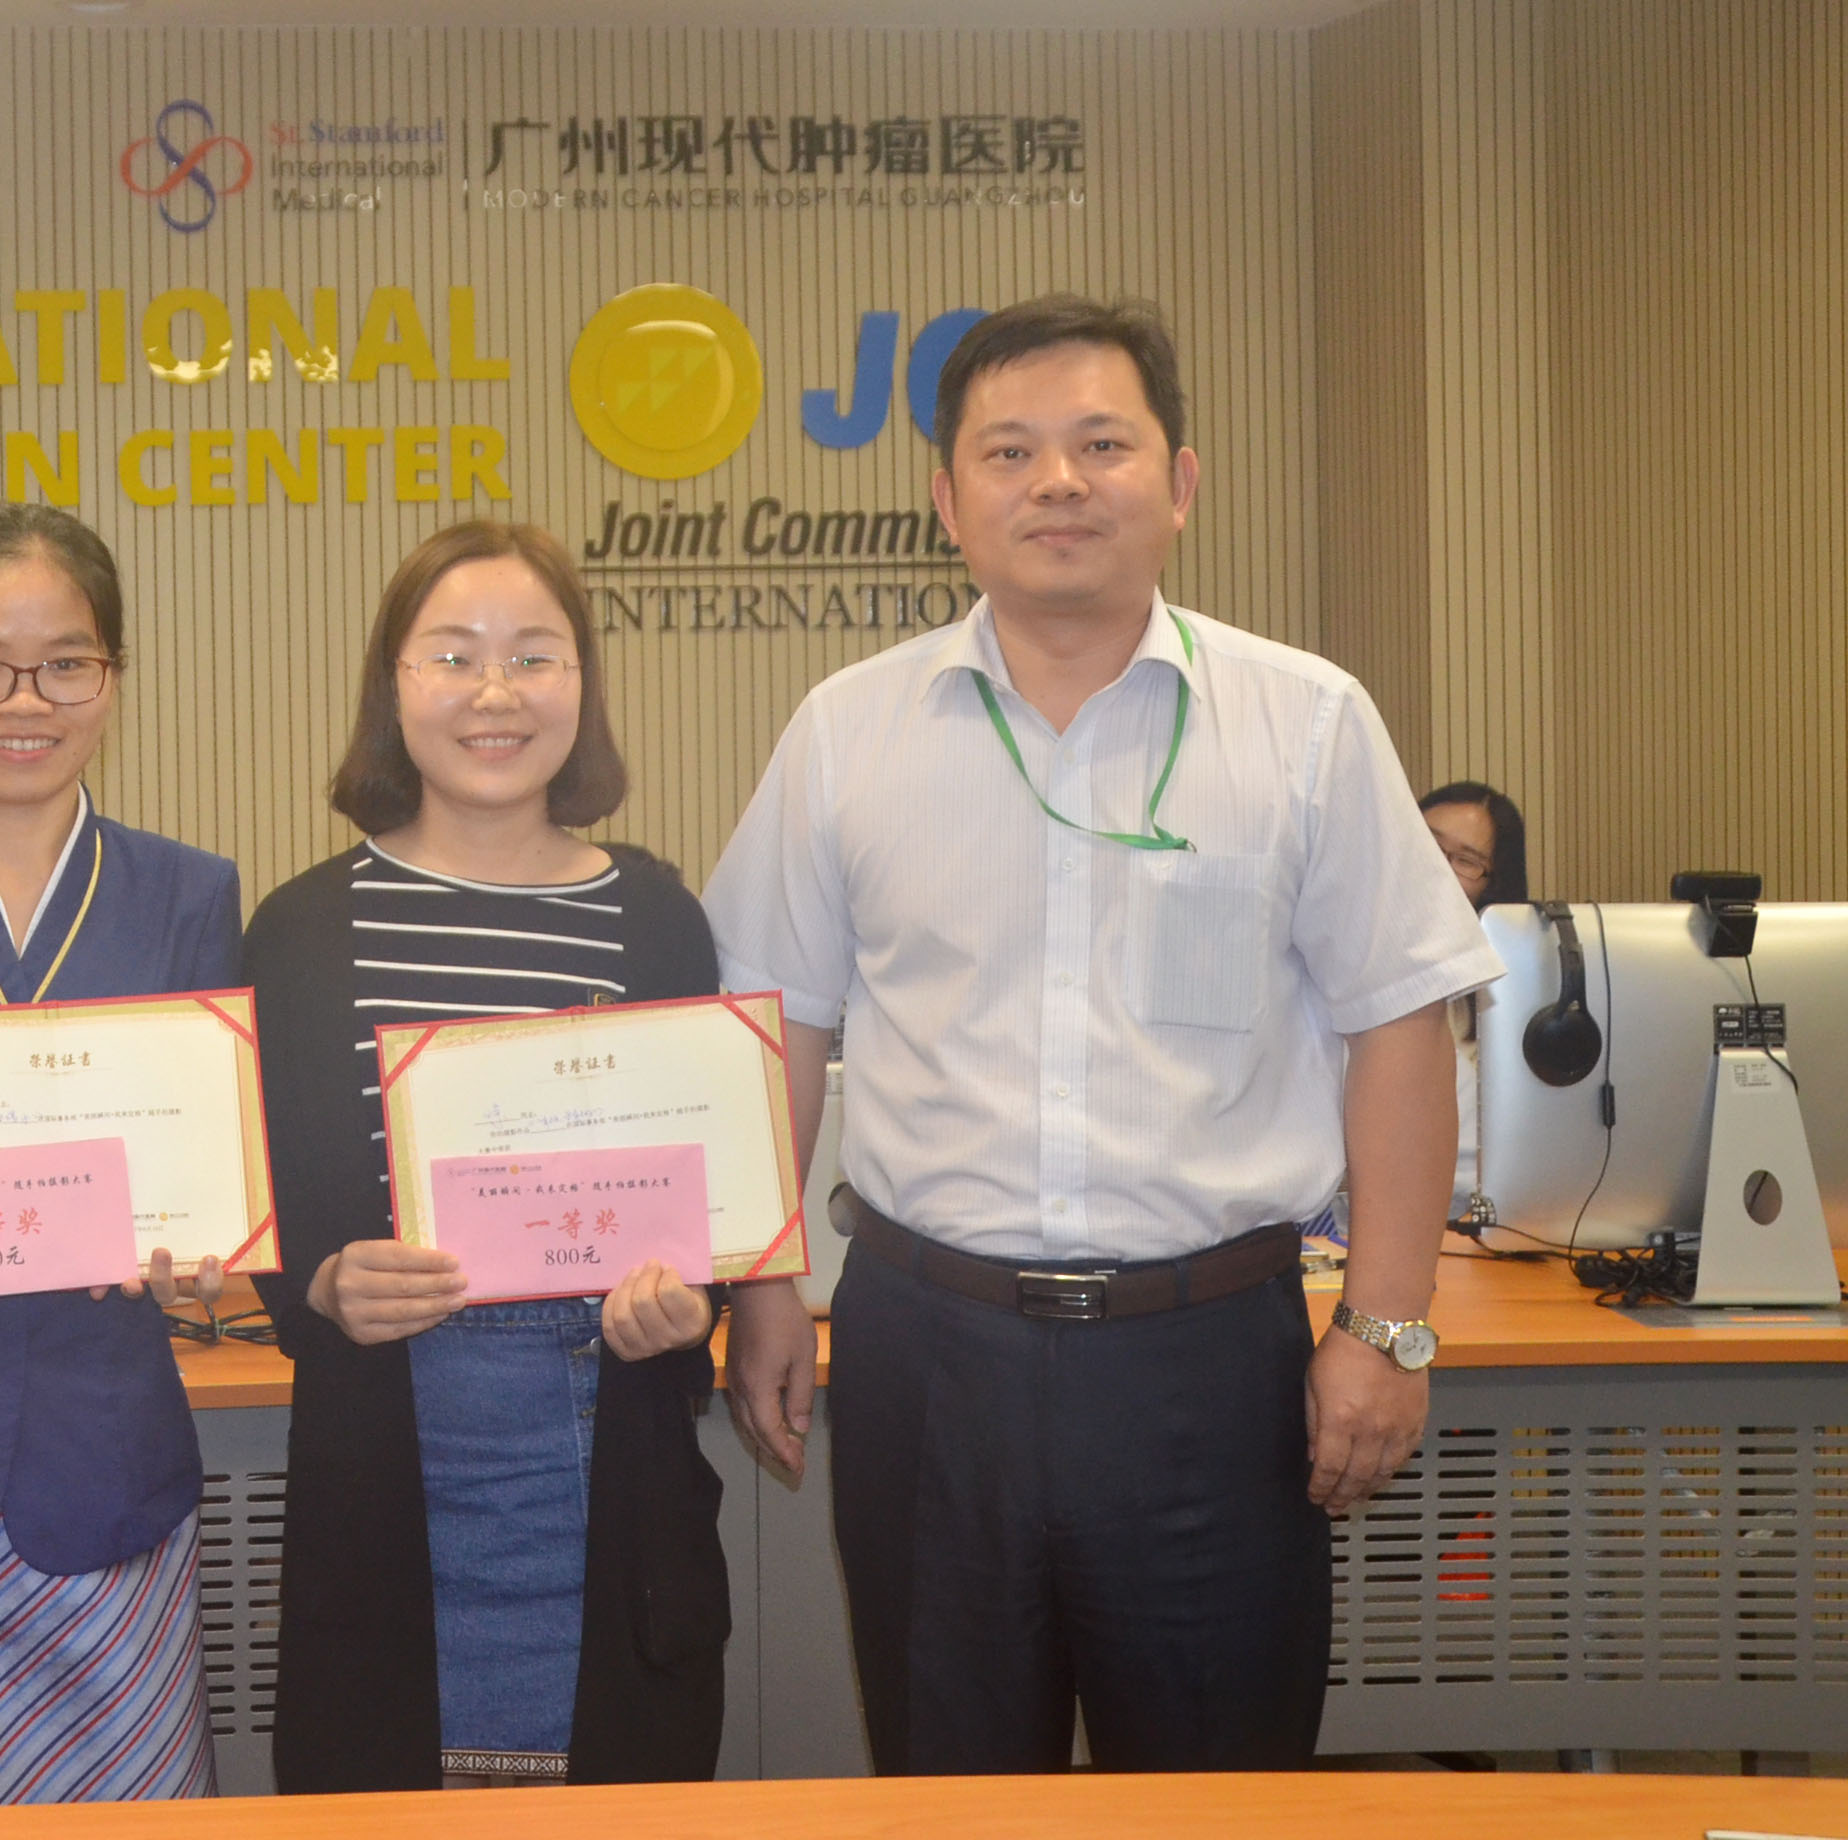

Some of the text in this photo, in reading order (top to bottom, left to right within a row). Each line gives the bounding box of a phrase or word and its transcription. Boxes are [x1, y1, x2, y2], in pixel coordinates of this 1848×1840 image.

[484, 114, 1087, 176] 广州现代肿瘤医院
[271, 151, 444, 178] International
[273, 184, 382, 212] Medical
[483, 189, 609, 208] MODERN
[623, 187, 741, 208] CANCER
[754, 187, 893, 207] HOSPITAL
[118, 423, 512, 506] CENTER
[583, 498, 727, 559] Joint
[524, 1208, 621, 1240] 一等奖
[544, 1244, 602, 1267] 800元
